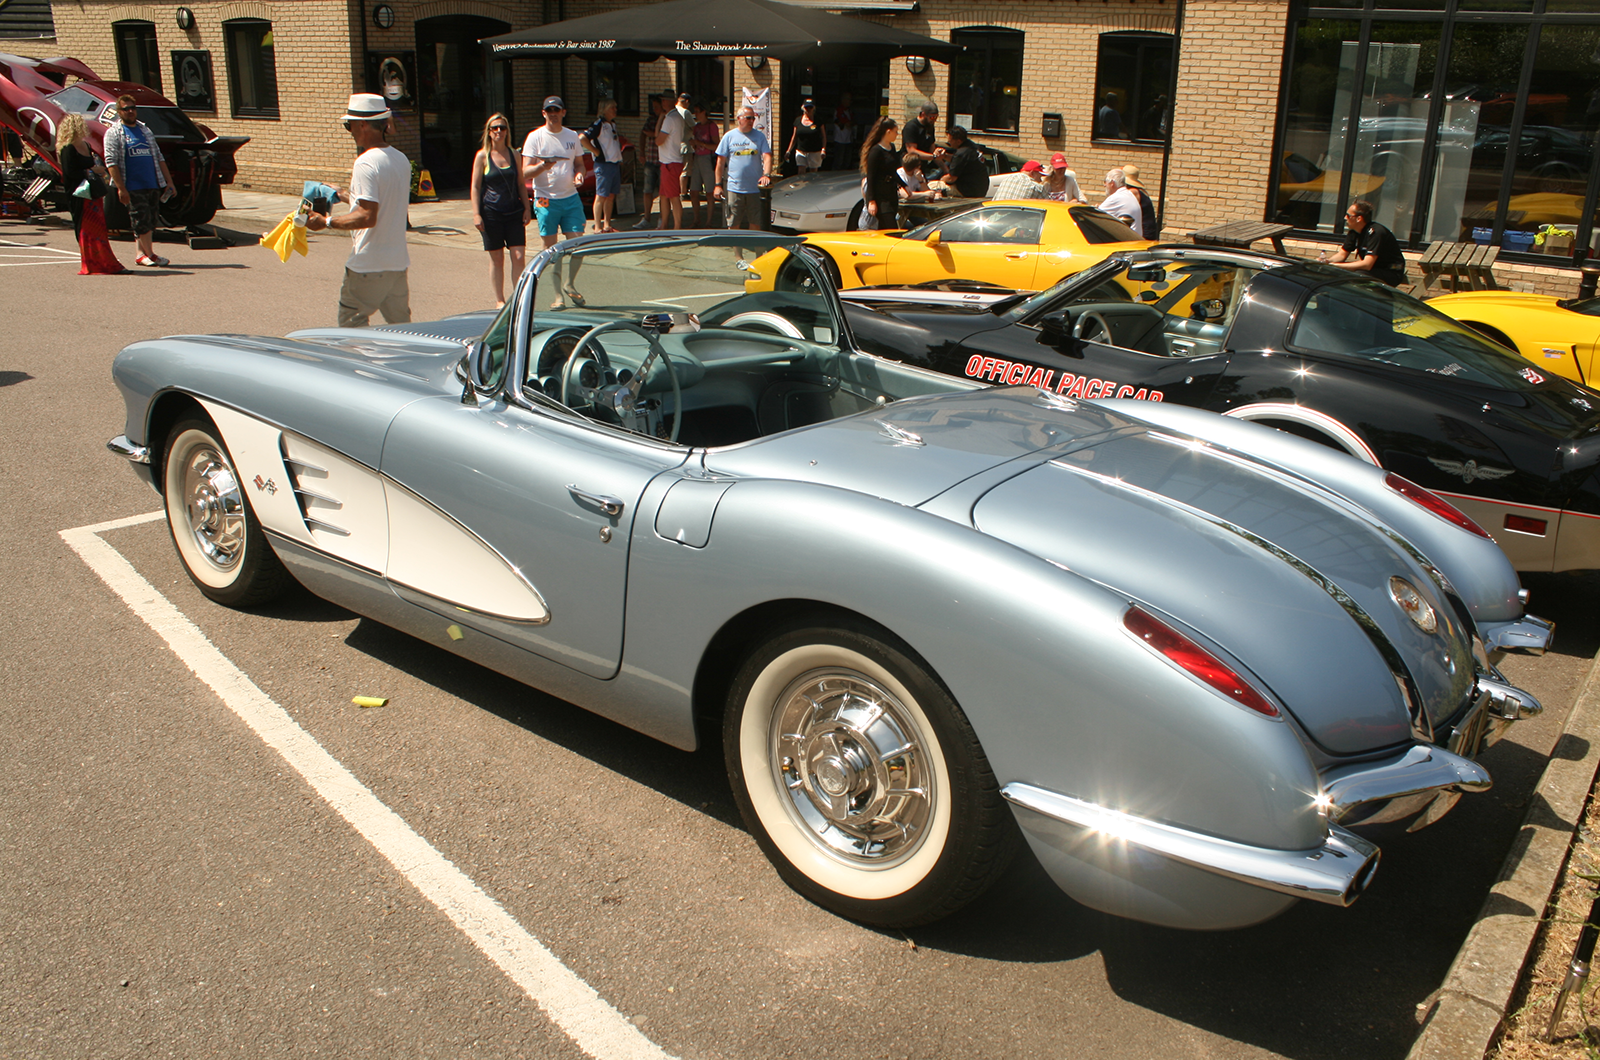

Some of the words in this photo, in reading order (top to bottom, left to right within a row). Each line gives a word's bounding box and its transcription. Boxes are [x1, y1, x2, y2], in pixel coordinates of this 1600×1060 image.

[558, 41, 565, 49] &
[566, 40, 578, 49] Bar
[579, 40, 597, 49] since
[598, 40, 616, 49] 1987
[675, 40, 691, 51] The
[566, 142, 576, 150] JW
[965, 354, 1055, 391] OFFICIAL
[1056, 372, 1117, 400] PACE
[1115, 385, 1164, 402] CAR
